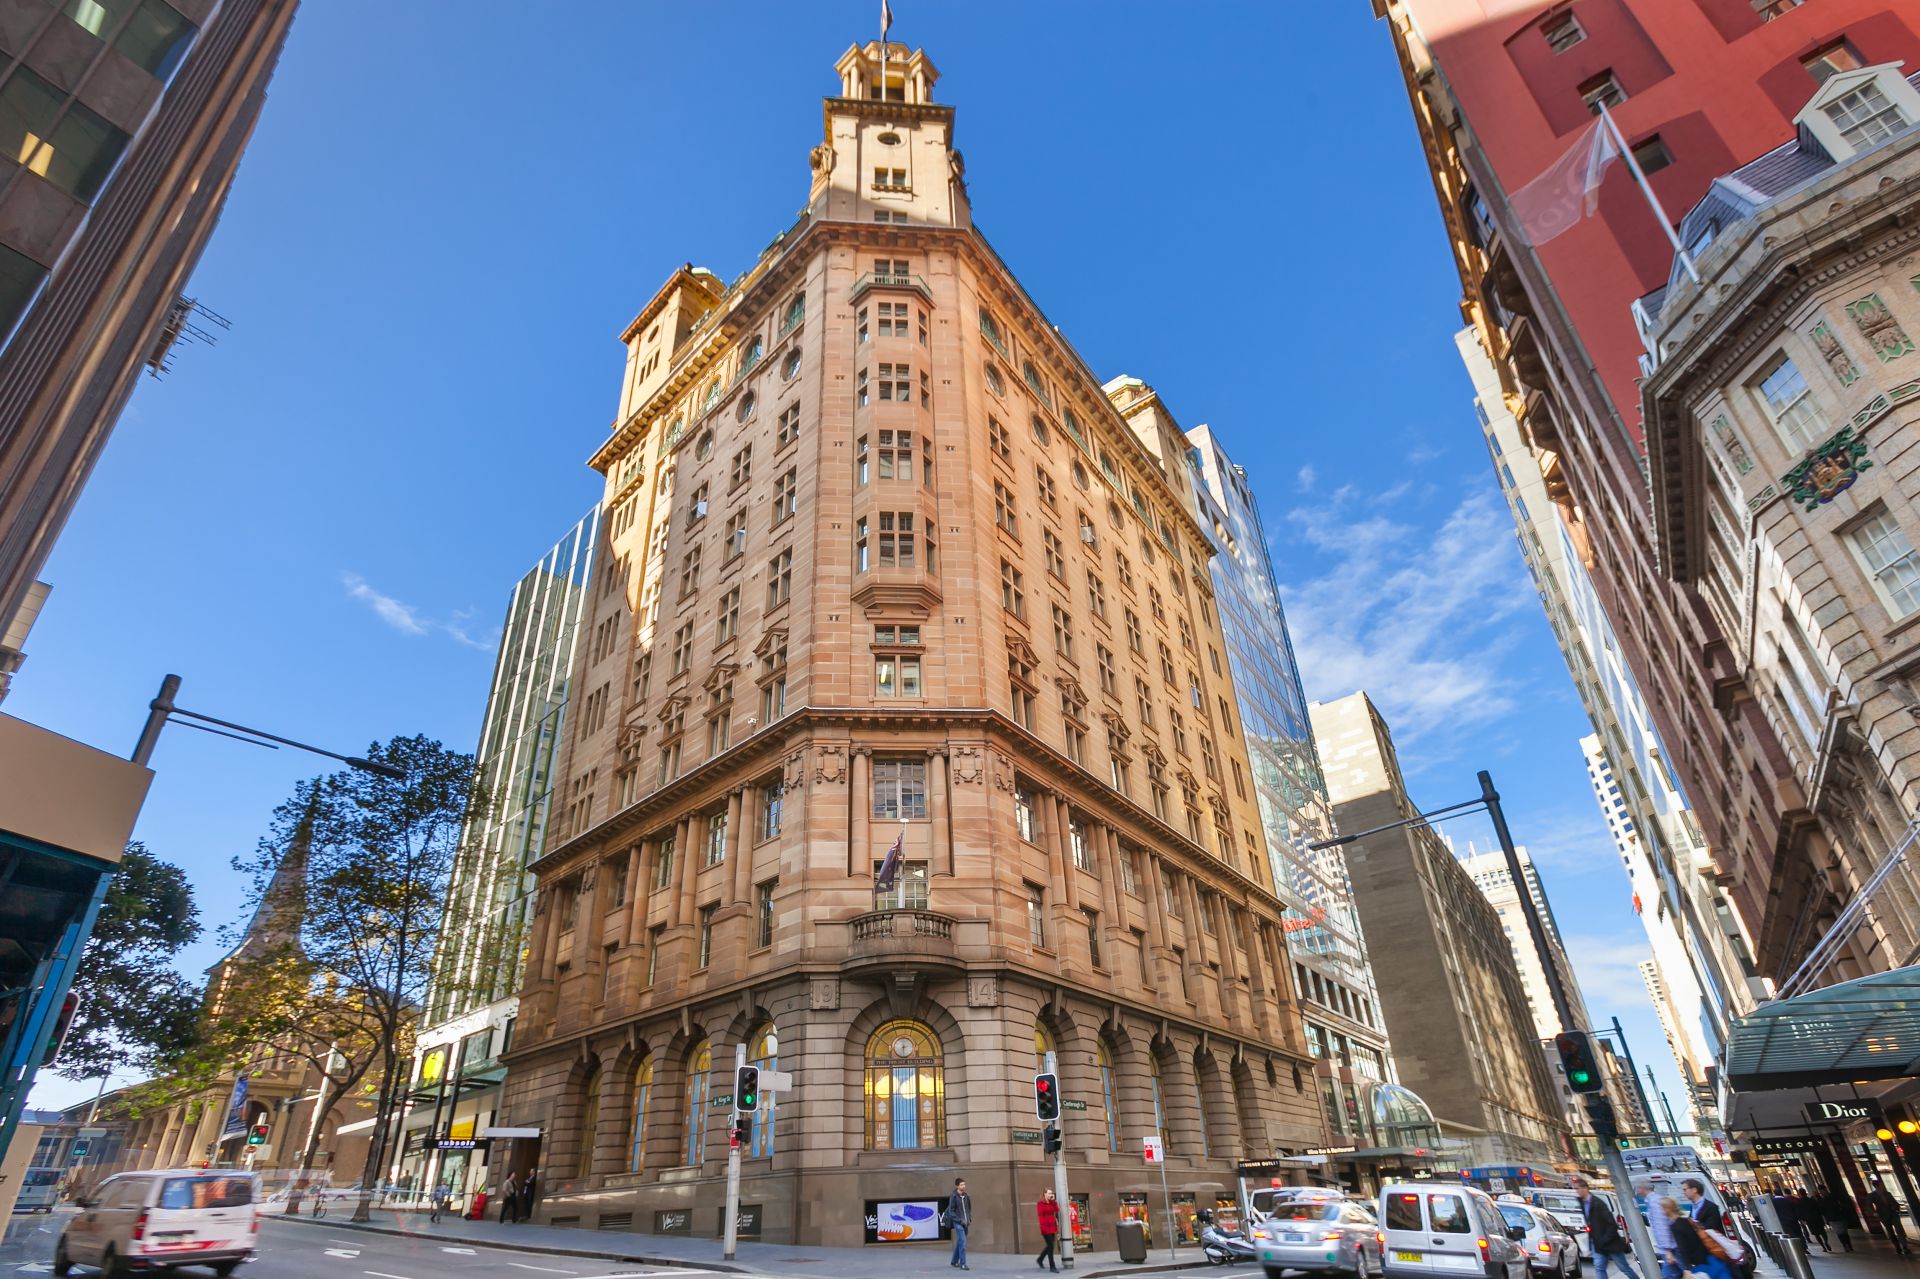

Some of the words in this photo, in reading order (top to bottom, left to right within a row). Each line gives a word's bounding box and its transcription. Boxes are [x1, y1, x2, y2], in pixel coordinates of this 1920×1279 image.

[815, 984, 833, 1003] 19
[974, 982, 991, 1001] 14
[1819, 1102, 1868, 1119] Dior
[1755, 1140, 1823, 1150] GREGORY
